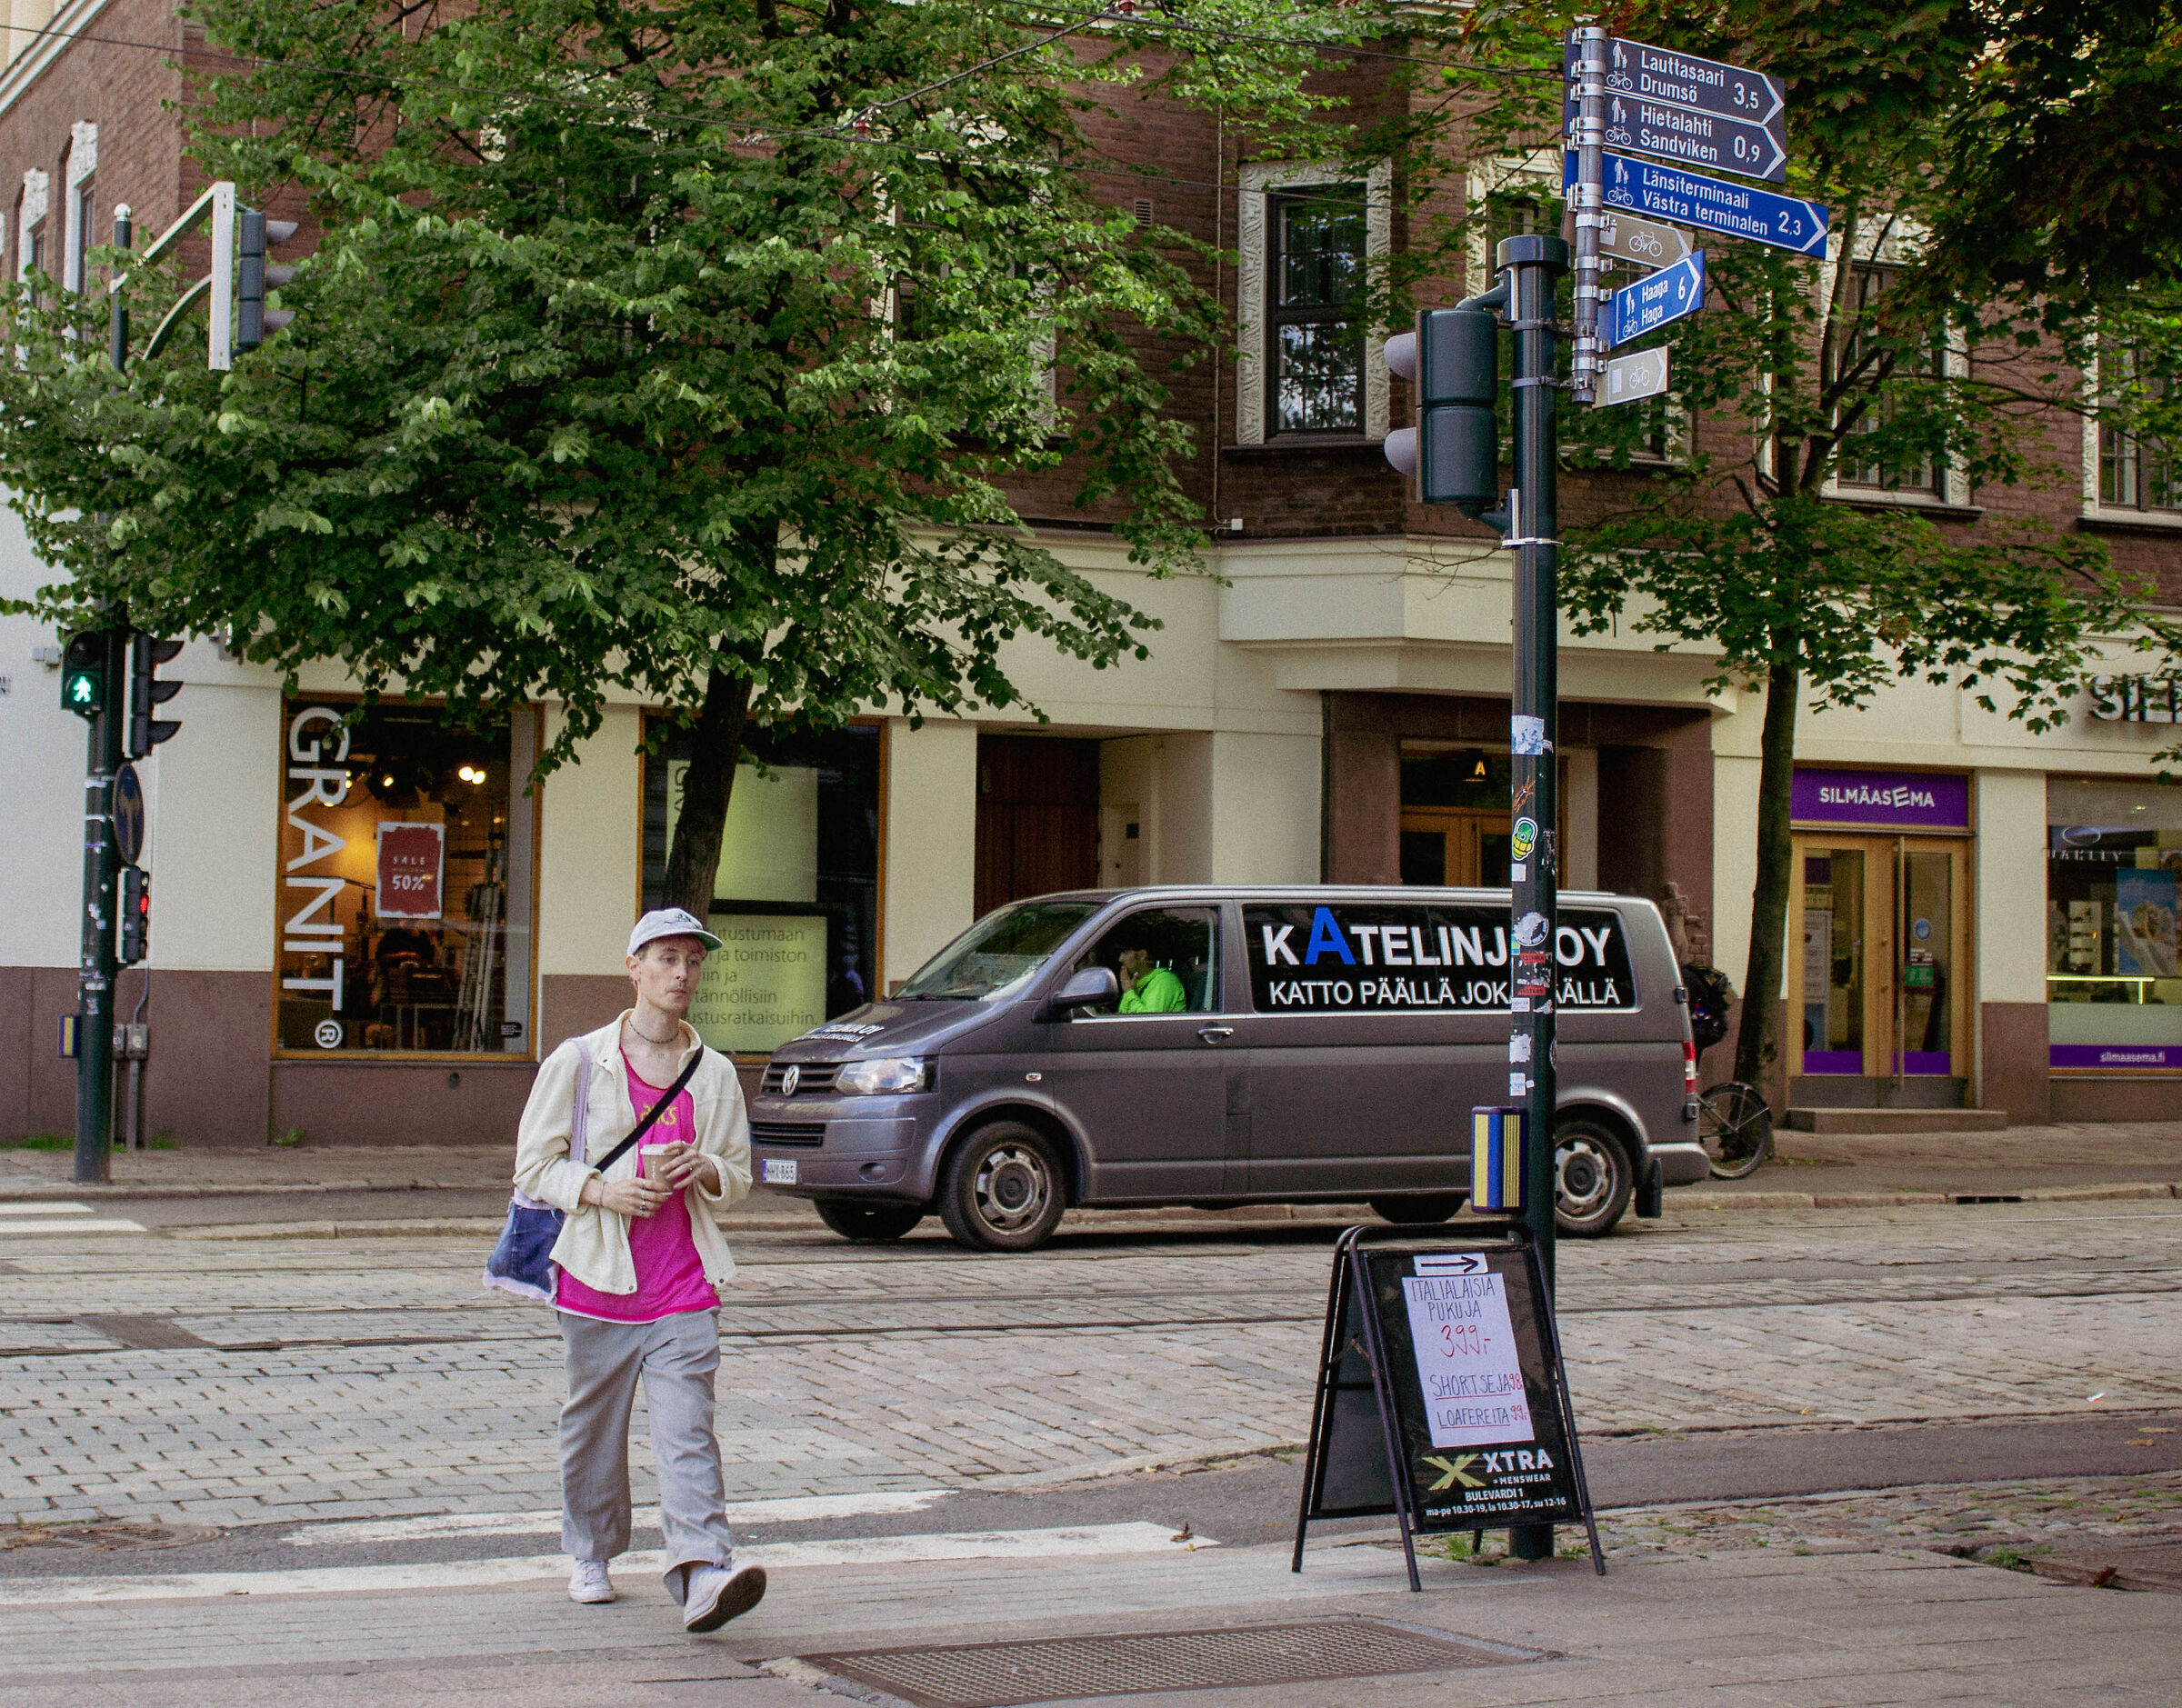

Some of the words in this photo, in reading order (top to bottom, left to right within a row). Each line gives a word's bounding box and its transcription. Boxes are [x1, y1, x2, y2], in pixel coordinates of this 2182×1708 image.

[1641, 51, 1725, 88] Lauttasaari
[1640, 73, 1697, 103] Drumsö
[1733, 83, 1759, 110] 3,5
[1641, 105, 1712, 138] Hietalahti
[1640, 131, 1717, 162] Sandviken
[1734, 135, 1760, 164] 0,9
[1643, 167, 1749, 210] Länsiterminaali
[1643, 189, 1688, 216] Västra
[1696, 202, 1767, 236] terminalen
[1778, 211, 1802, 236] 2,3
[1641, 278, 1668, 305] Haaga
[1677, 276, 1687, 300] 6
[1641, 305, 1663, 326] Haga
[1819, 785, 1935, 808] SILMÄASEMA
[282, 706, 352, 1011] GRANIT
[392, 856, 426, 865] SALE
[392, 874, 425, 891] 50%
[1263, 907, 1507, 965] KATELINJ
[1556, 925, 1612, 967] OY
[735, 948, 807, 963] toimiston
[694, 988, 777, 1004] tännöllisiin
[1269, 981, 1353, 1005] KATTO
[1361, 977, 1456, 1005] PÄÄLLÄ
[1460, 981, 1512, 1005] JOK
[1556, 977, 1621, 1005] ÄLLÄ
[1411, 1277, 1496, 1302] ITALIALAISIA
[1428, 1301, 1482, 1321] PUKUJA
[1437, 1407, 1510, 1427] LOAFEREITA
[1482, 1448, 1555, 1473] XTRA
[1426, 1505, 1452, 1517] ma-pe
[1533, 1500, 1543, 1508] su
[1545, 1496, 1566, 1507] 12-16
[1465, 1488, 1516, 1502] BULEVARDI
[1518, 1487, 1524, 1497] 1
